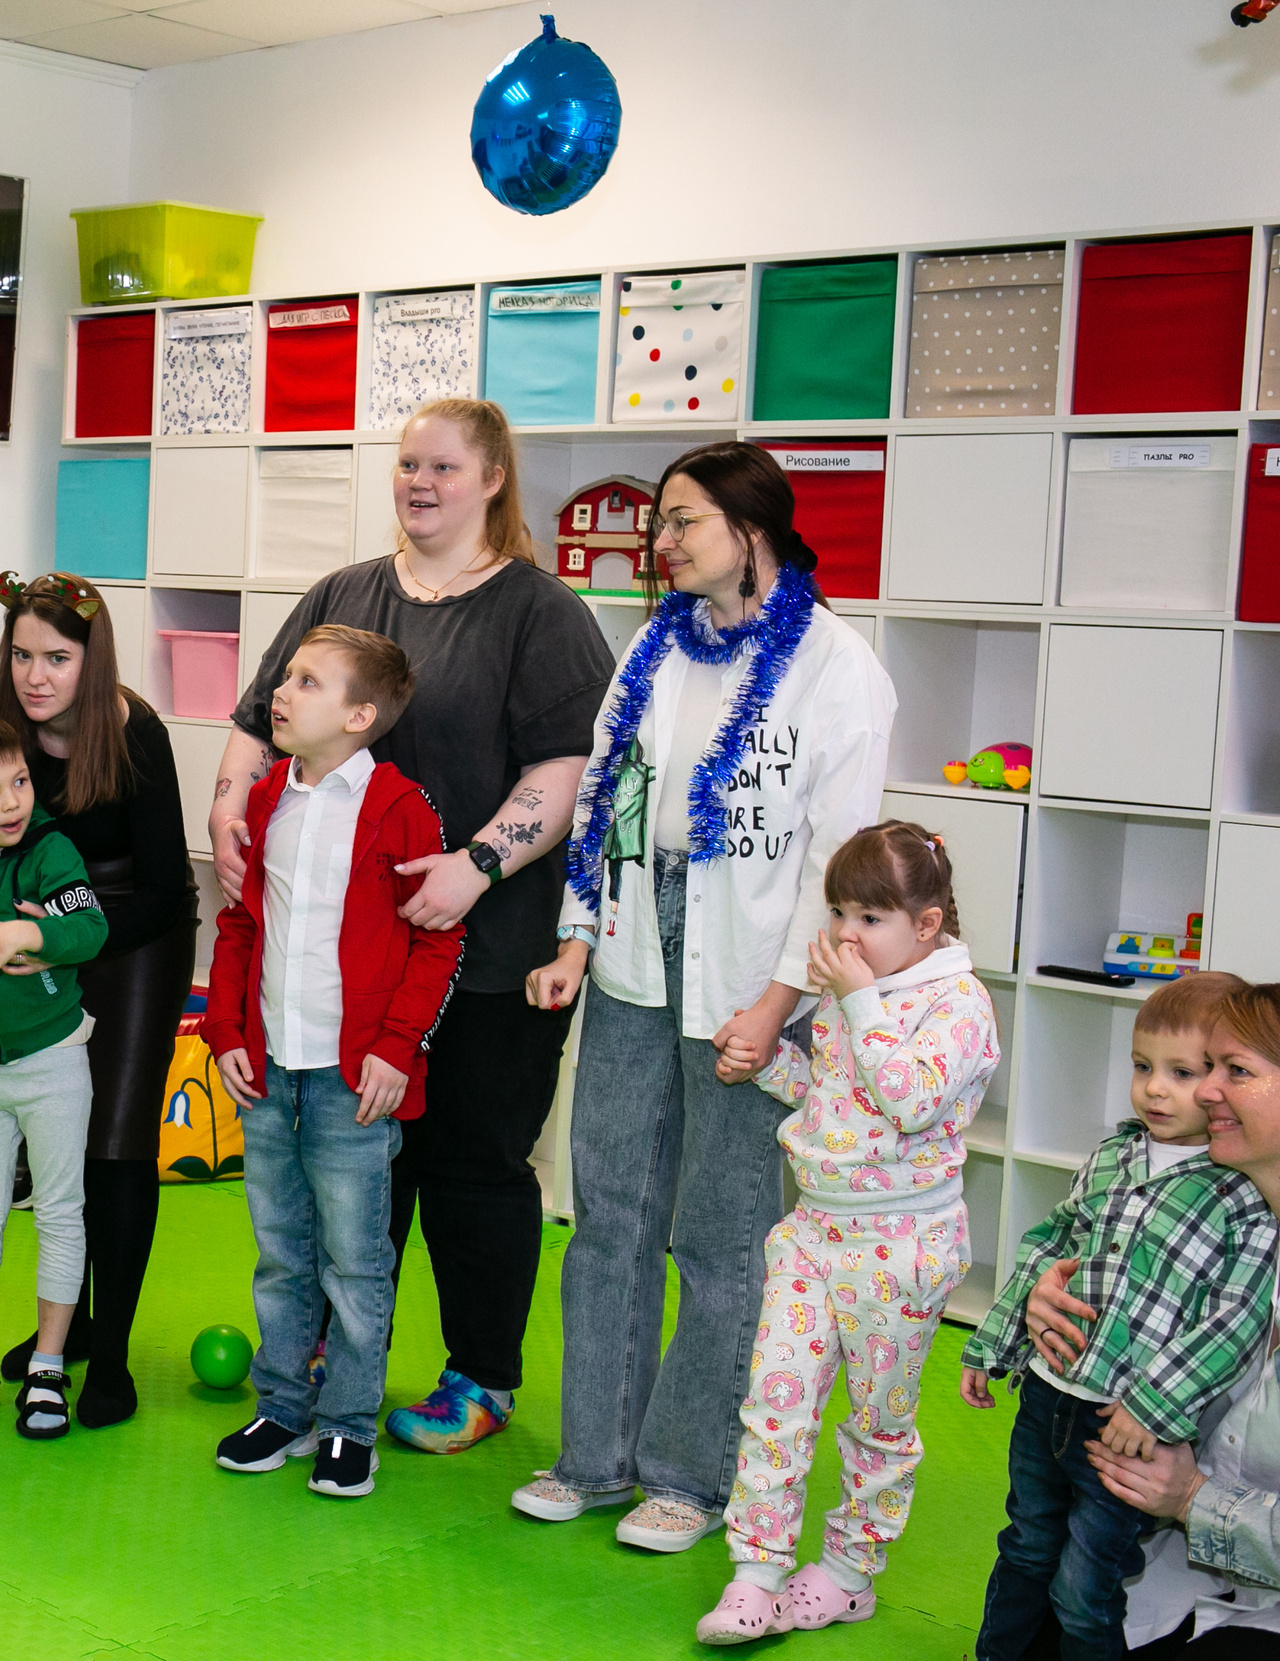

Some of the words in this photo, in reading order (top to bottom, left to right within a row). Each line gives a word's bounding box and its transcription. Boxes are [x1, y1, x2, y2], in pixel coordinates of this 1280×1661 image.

[430, 307, 441, 316] pro
[786, 455, 850, 466] Рисование
[754, 705, 770, 722] I
[744, 725, 799, 760] ALLY
[728, 806, 765, 832] ARE
[765, 831, 793, 860] U?
